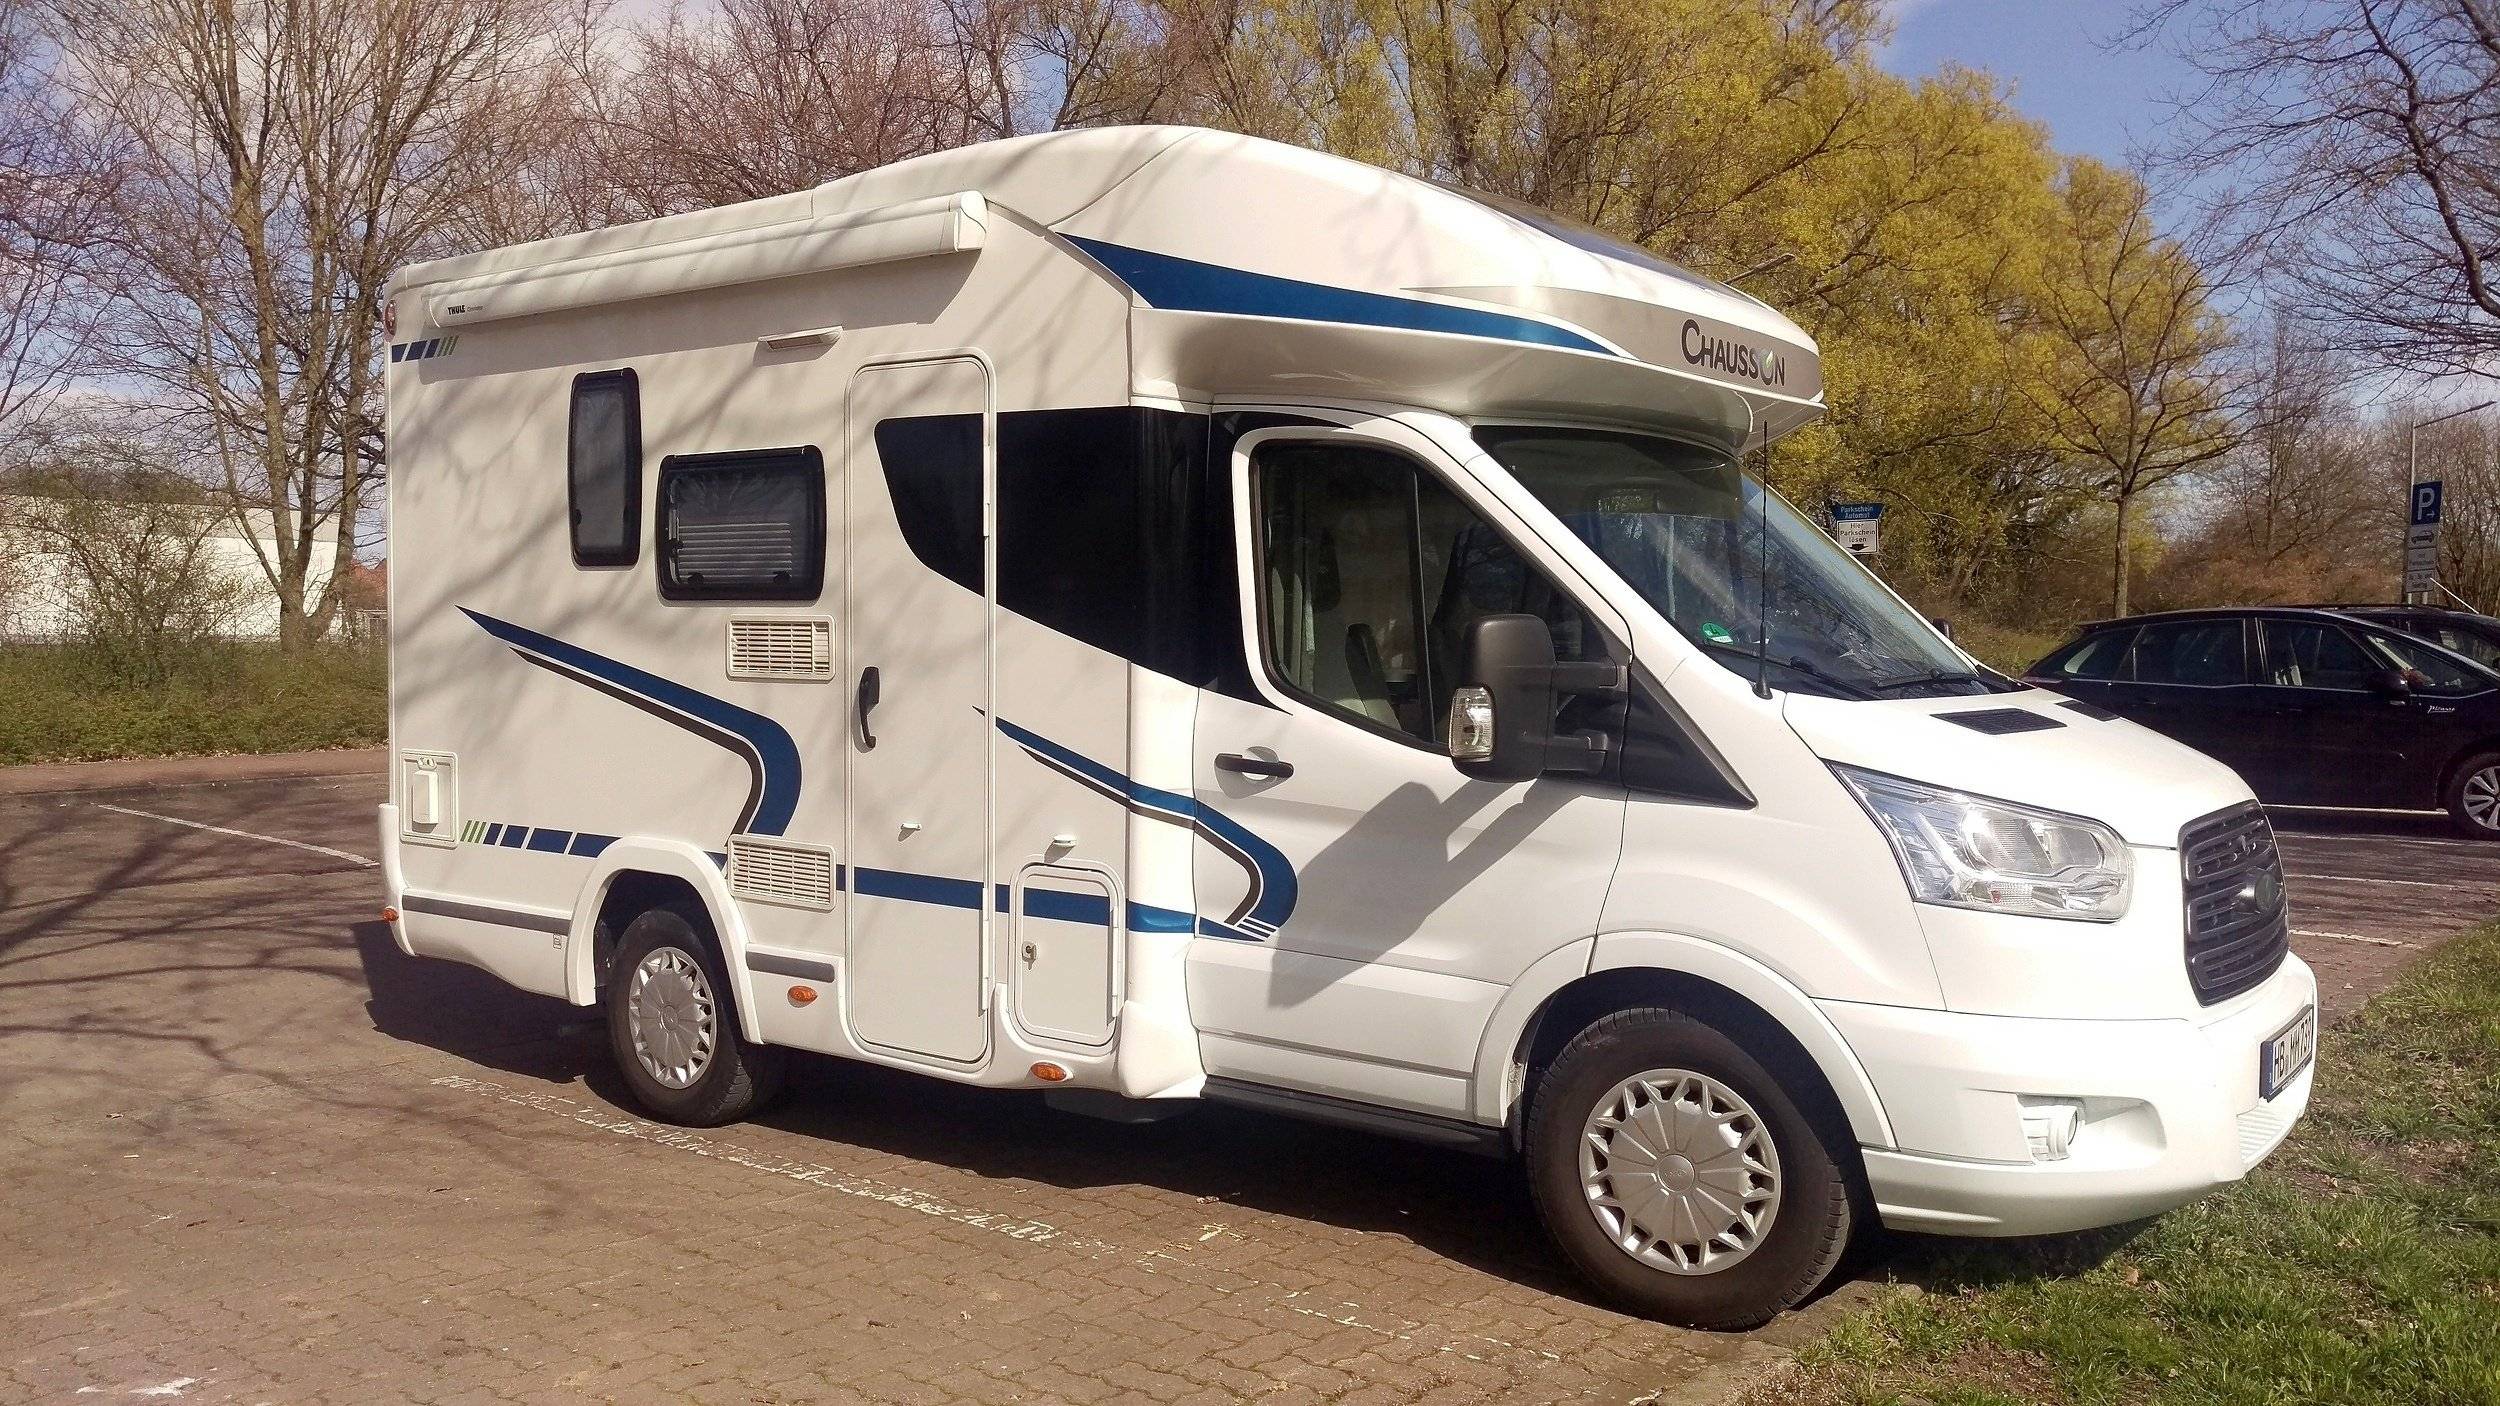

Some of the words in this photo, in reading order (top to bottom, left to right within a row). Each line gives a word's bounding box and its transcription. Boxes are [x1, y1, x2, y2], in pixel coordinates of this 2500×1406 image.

[448, 305, 465, 315] THULE
[1681, 318, 1785, 386] CHAUSSON
[2417, 487, 2435, 520] P
